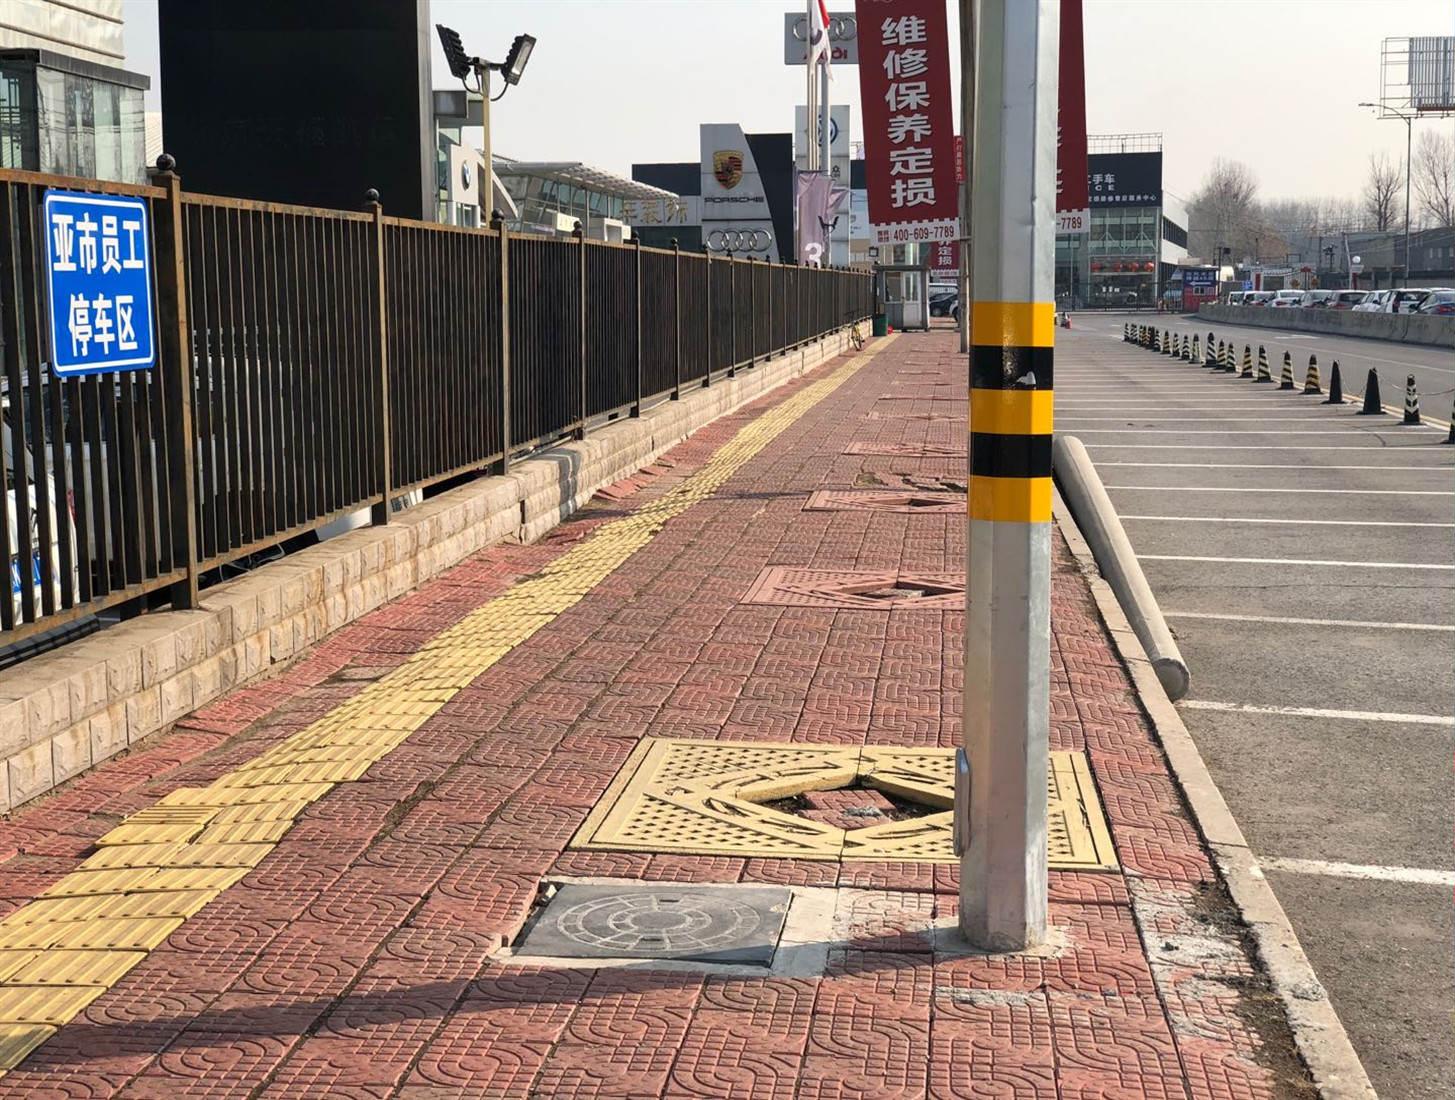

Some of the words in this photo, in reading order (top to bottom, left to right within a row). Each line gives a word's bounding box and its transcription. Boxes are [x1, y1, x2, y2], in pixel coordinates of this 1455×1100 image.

[881, 15, 936, 208] 维修保养定损
[52, 212, 144, 275] 亚市员工
[893, 225, 955, 241] 400-609-7789
[68, 293, 138, 357] 停车区
